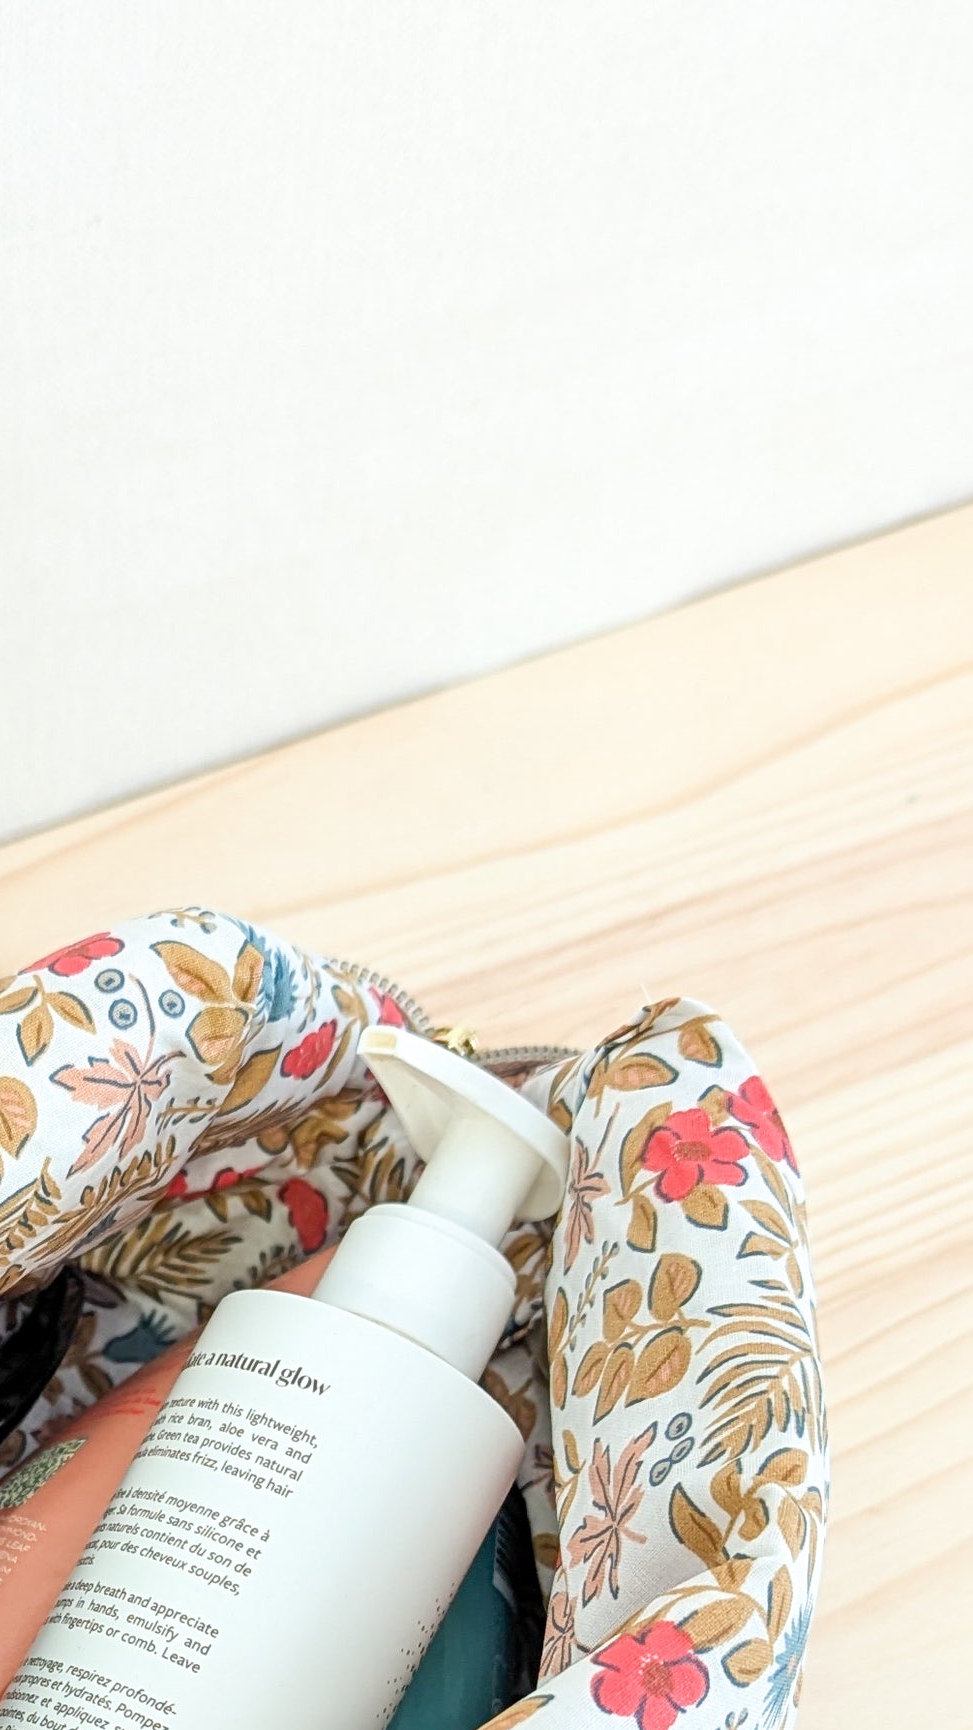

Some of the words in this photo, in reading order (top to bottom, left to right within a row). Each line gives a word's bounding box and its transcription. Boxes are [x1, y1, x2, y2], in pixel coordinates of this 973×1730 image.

[205, 1353, 216, 1365] a
[215, 1353, 281, 1377] natural
[275, 1367, 330, 1395] glow
[167, 1413, 184, 1424] rice
[187, 1413, 212, 1430] bran,
[219, 1422, 244, 1437] aloe
[252, 1433, 278, 1450] vera
[285, 1447, 312, 1464] and
[197, 1398, 220, 1411] with
[222, 1402, 244, 1417] this
[246, 1408, 317, 1449] lightweight,
[147, 1445, 191, 1461] eliminates
[192, 1451, 218, 1471] frizz,
[221, 1460, 266, 1490] leaving
[266, 1478, 293, 1498] hair
[157, 1429, 182, 1440] Green
[183, 1432, 200, 1444] tea
[199, 1438, 252, 1460] provides
[255, 1455, 303, 1482] natural
[127, 1504, 166, 1522] formule
[166, 1516, 194, 1531] sans
[194, 1525, 244, 1551] silicone
[246, 1548, 261, 1560] et
[131, 1488, 167, 1503] densité
[165, 1496, 220, 1520] moyenne
[218, 1515, 259, 1537] grâce
[260, 1529, 270, 1542] à
[97, 1540, 121, 1551] pour
[120, 1540, 139, 1554] des
[139, 1546, 188, 1570] cheveux
[188, 1565, 239, 1596] souples,
[105, 1522, 140, 1535] naturels
[140, 1528, 188, 1549] contient
[189, 1543, 207, 1557] du
[207, 1552, 232, 1568] son
[234, 1563, 252, 1577] de
[74, 1579, 94, 1594] deep
[93, 1581, 127, 1600] breath
[127, 1594, 152, 1608] and
[150, 1602, 219, 1638] appreciate
[75, 1597, 85, 1608] in
[87, 1599, 119, 1620] hands,
[126, 1614, 179, 1643] emulsify
[184, 1638, 212, 1656] and
[61, 1613, 104, 1634] fingertips
[105, 1627, 121, 1637] or
[121, 1633, 157, 1655] comb.
[161, 1647, 200, 1673] Leave
[40, 1698, 52, 1708] et
[53, 1702, 110, 1730] appliquez
[50, 1681, 63, 1691] et
[61, 1681, 112, 1710] hydratés.
[65, 1665, 112, 1687] respirez
[109, 1682, 176, 1715] profondé-
[26, 1711, 40, 1724] du
